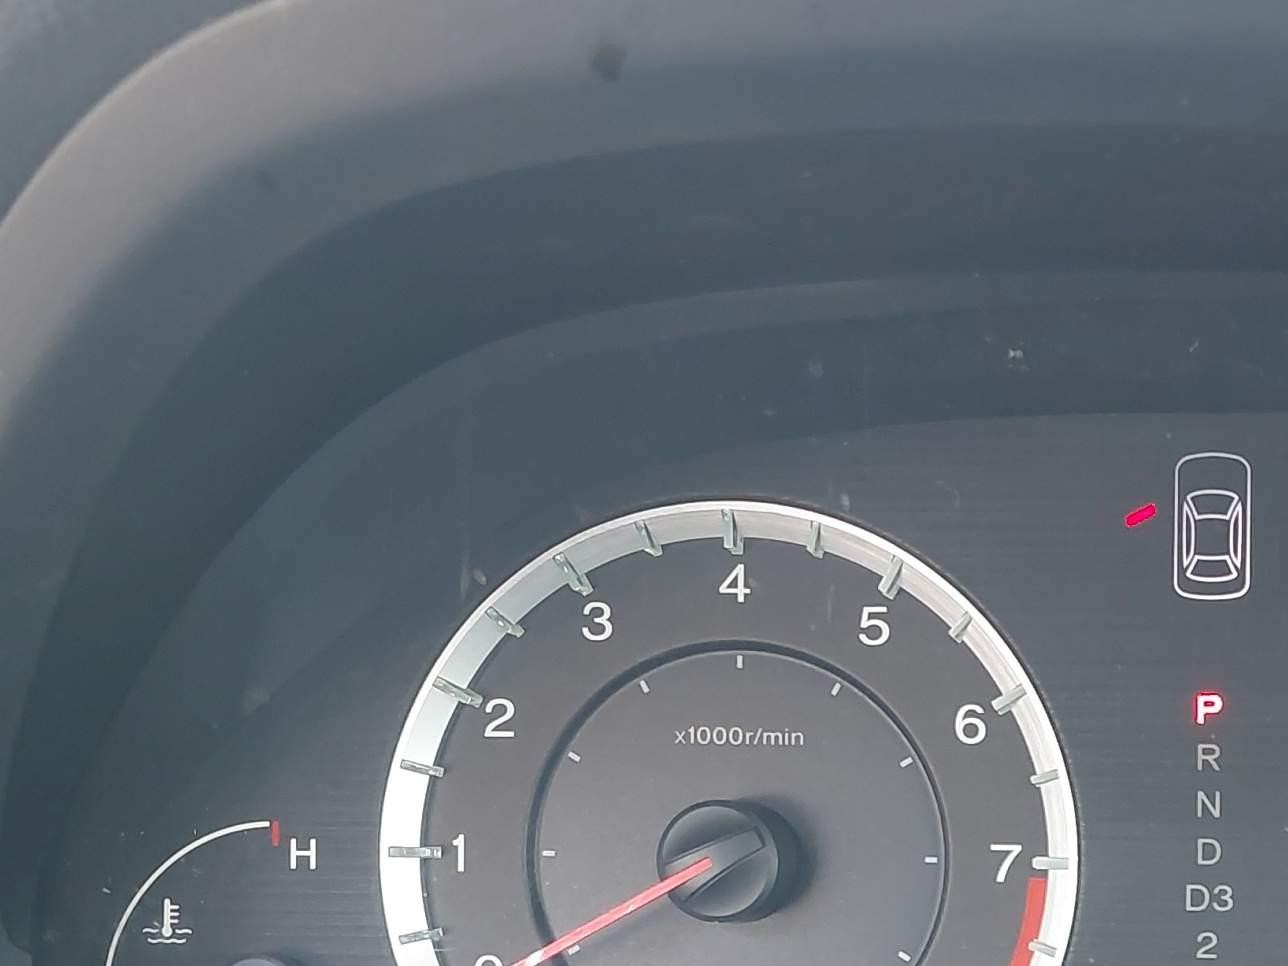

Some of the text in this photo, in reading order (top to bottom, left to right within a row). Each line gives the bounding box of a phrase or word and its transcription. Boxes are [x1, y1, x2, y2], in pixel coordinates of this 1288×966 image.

[719, 565, 750, 602] 4
[582, 602, 613, 640] 3
[860, 608, 889, 645] 5
[484, 700, 515, 737] 2
[955, 706, 986, 744] 6
[1196, 695, 1222, 723] P
[1197, 746, 1220, 771] R
[1197, 792, 1220, 817] N
[290, 838, 317, 870] H
[451, 835, 465, 872] 1
[990, 845, 1022, 882] 7
[1197, 840, 1222, 865] D
[1186, 886, 1234, 911] D3
[1197, 933, 1217, 959] 2
